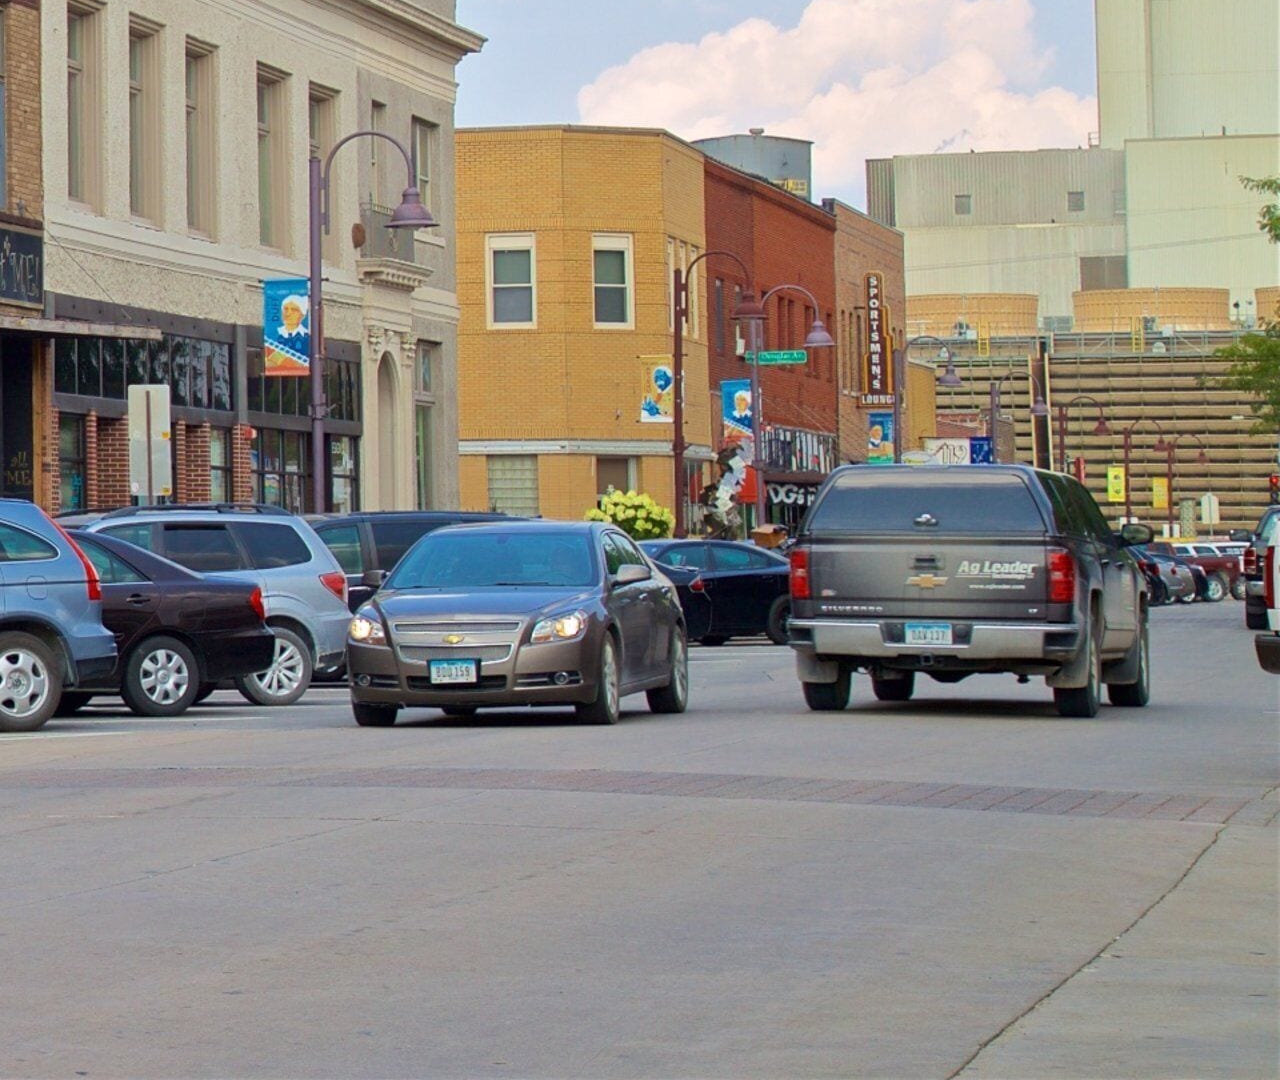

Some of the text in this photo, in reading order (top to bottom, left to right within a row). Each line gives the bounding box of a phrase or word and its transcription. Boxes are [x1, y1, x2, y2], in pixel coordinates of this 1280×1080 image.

[868, 275, 882, 390] SPORTSMEN'S
[958, 561, 1039, 575] Ag Leader
